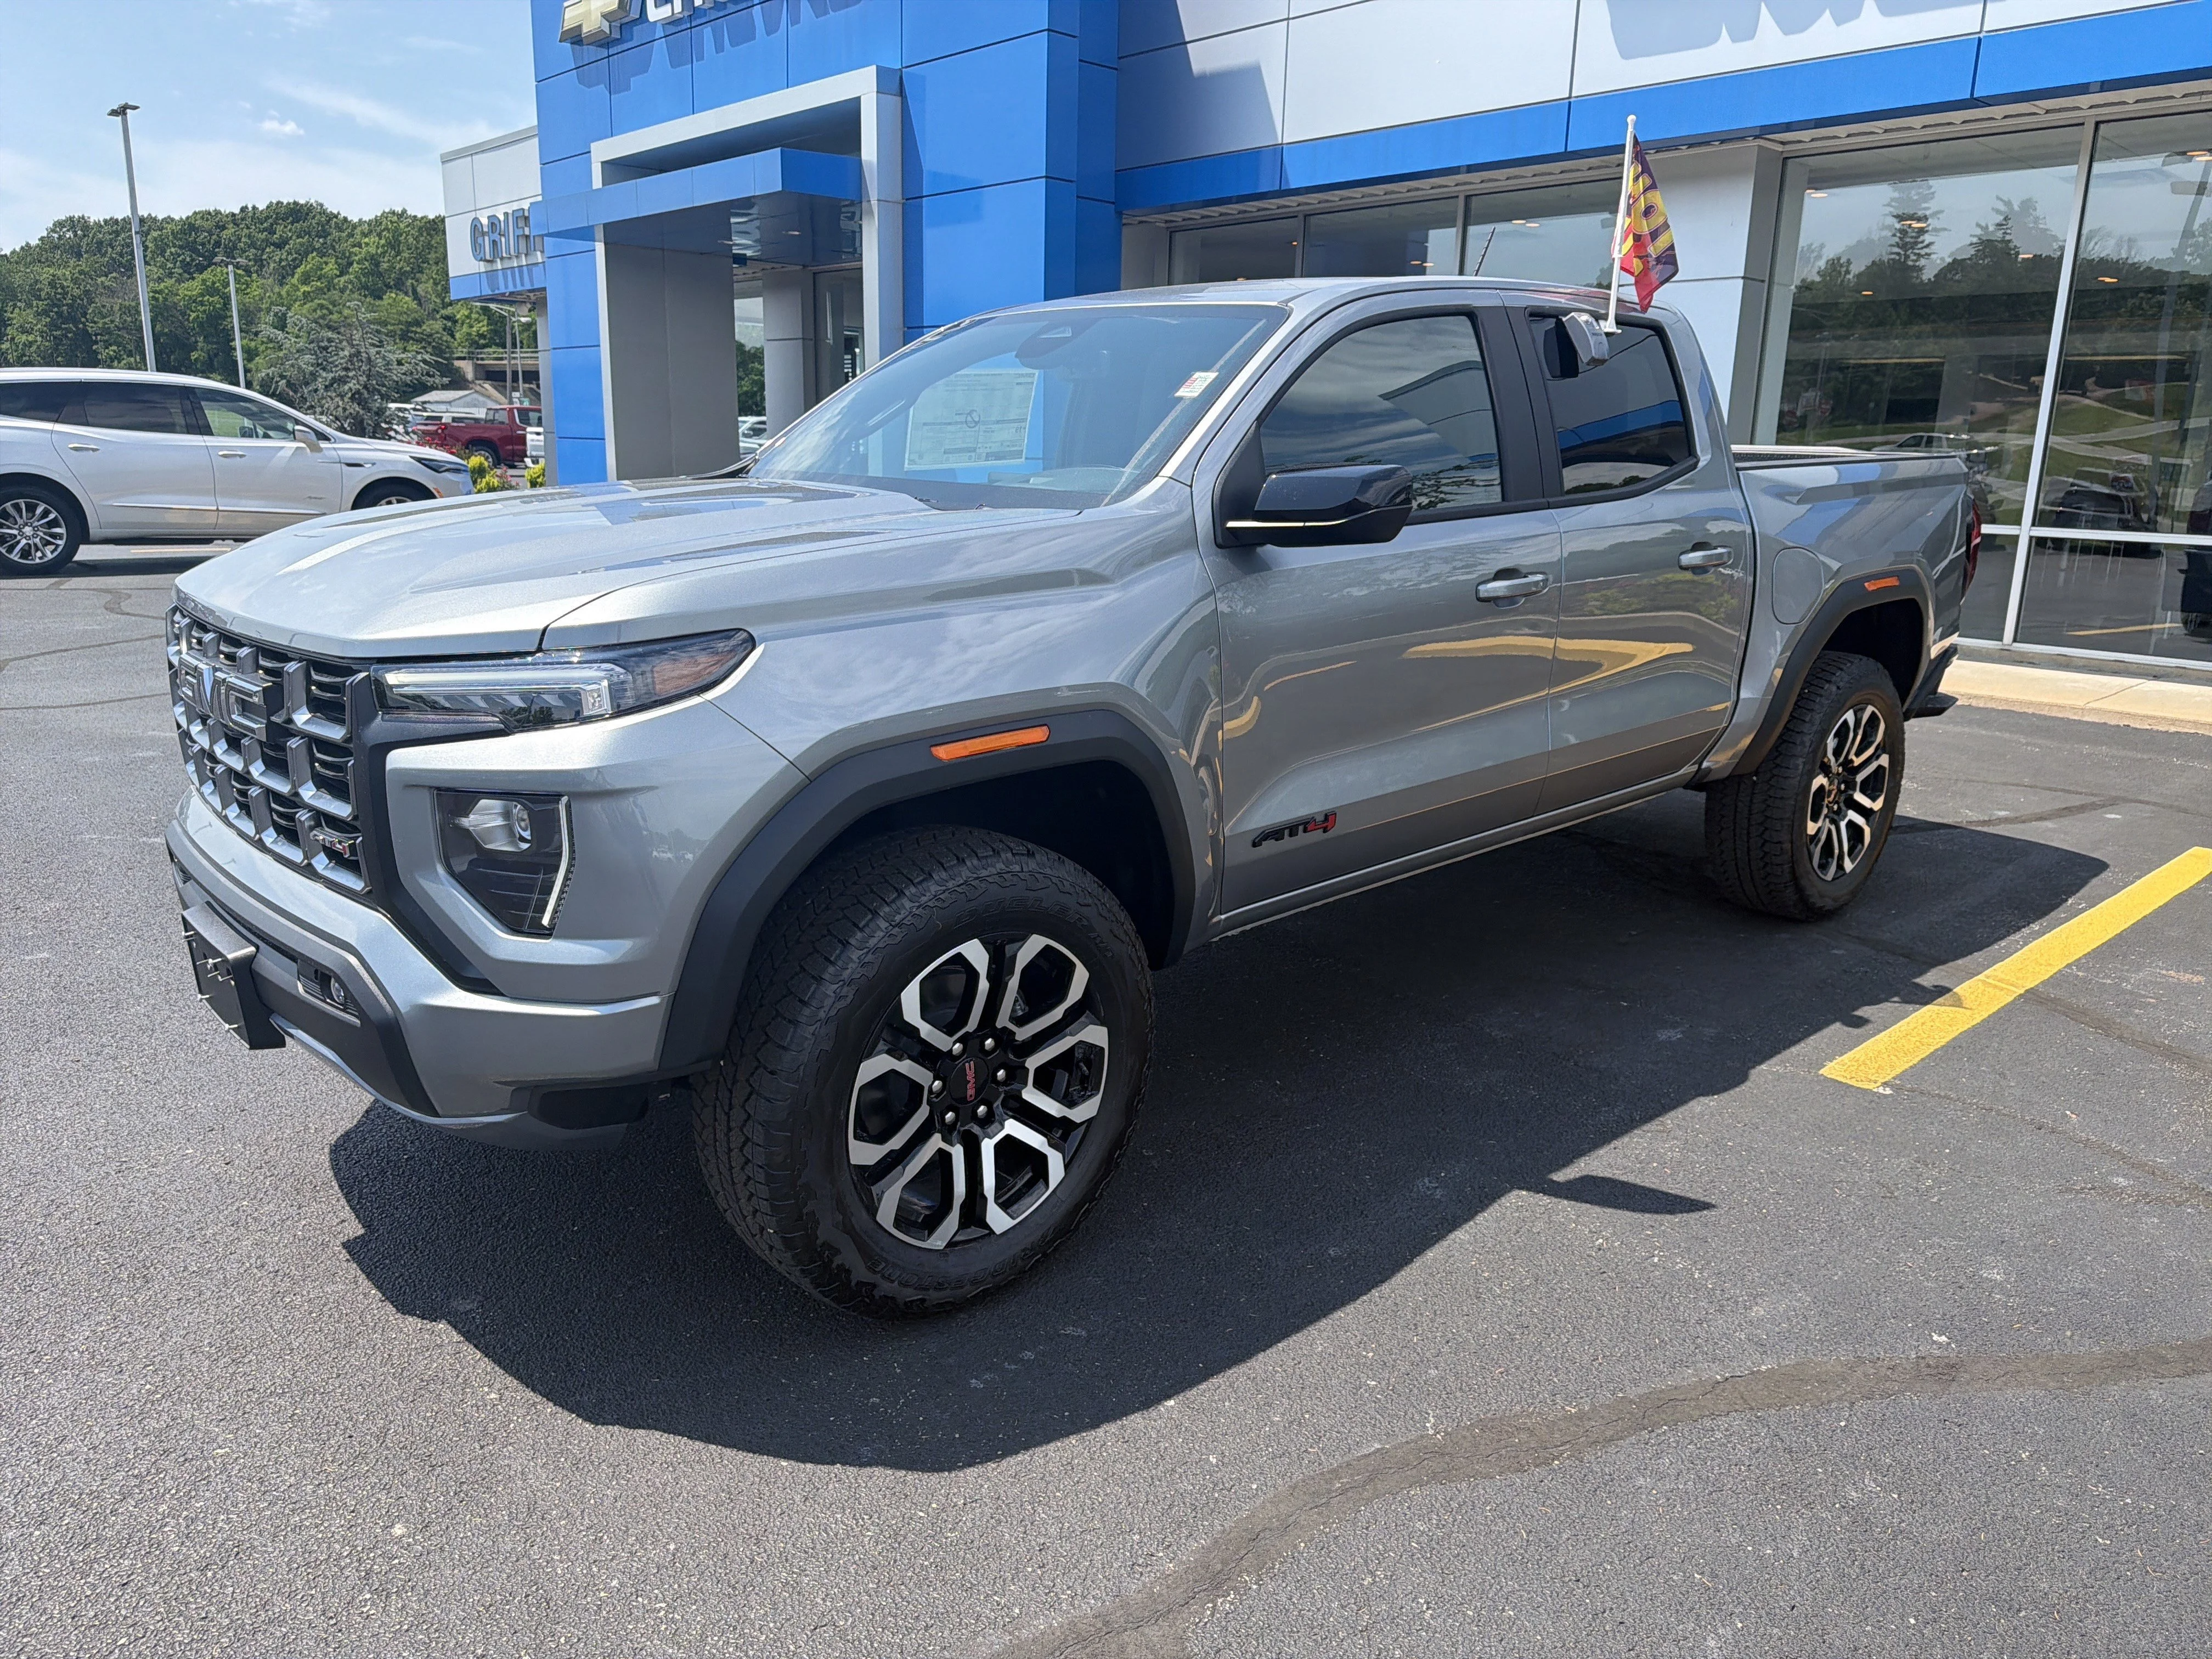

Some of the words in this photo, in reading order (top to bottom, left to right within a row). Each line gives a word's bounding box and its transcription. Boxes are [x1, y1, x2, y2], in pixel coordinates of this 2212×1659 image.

[179, 653, 267, 742] GMC
[1252, 811, 1336, 848] AT4
[966, 1060, 975, 1101] GMC
